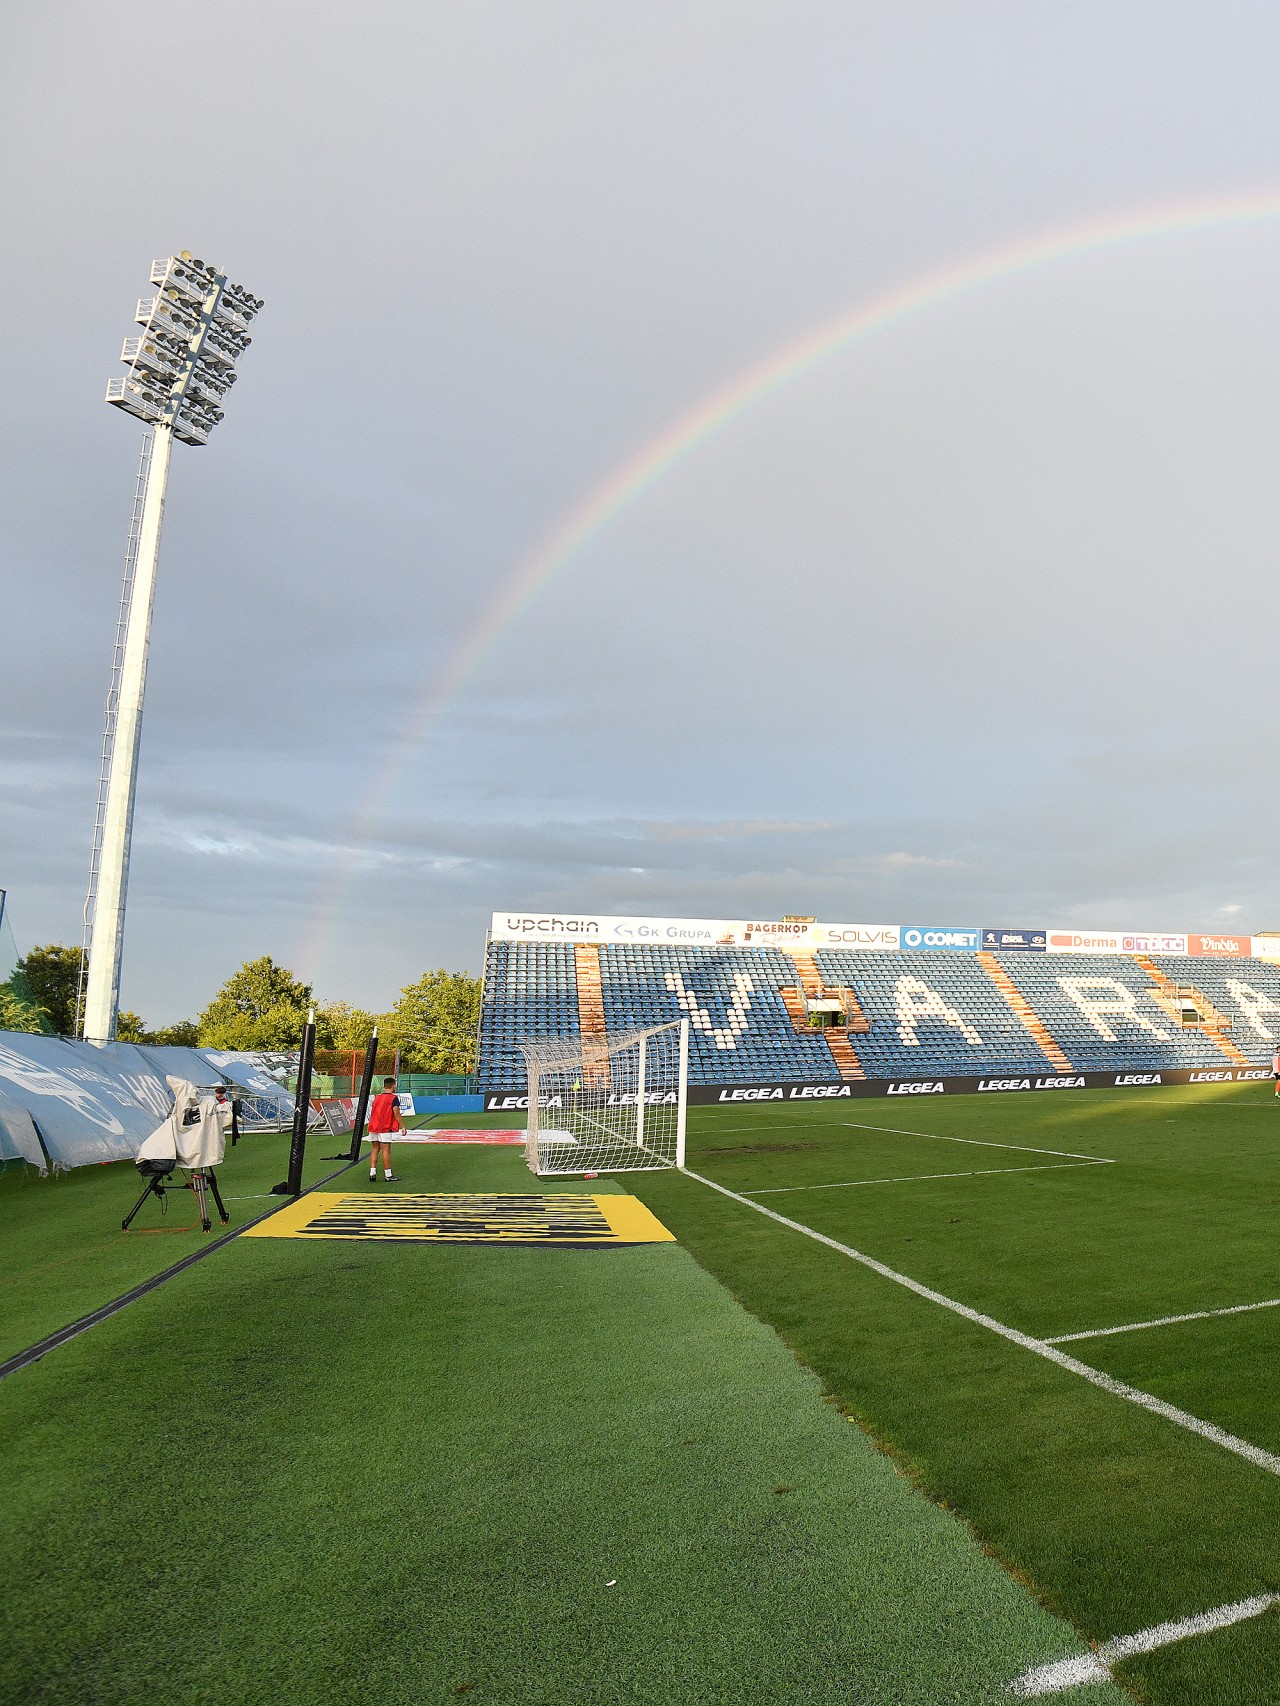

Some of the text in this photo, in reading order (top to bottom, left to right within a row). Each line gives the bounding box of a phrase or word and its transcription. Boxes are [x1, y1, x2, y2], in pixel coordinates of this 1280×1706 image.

[507, 918, 599, 932] upchain
[746, 923, 808, 933] BAGERKOP
[828, 930, 898, 943] SOLVIS
[923, 932, 977, 947] COMET
[1073, 935, 1117, 947] Derma
[1200, 937, 1239, 952] Vindija
[1115, 1074, 1162, 1085] LEGEA
[1189, 1071, 1233, 1082] LEGEA
[887, 1082, 944, 1095] LEGEA
[978, 1077, 1086, 1091] LEGEA LEGEA
[719, 1085, 851, 1101] LEGEA LEGEA
